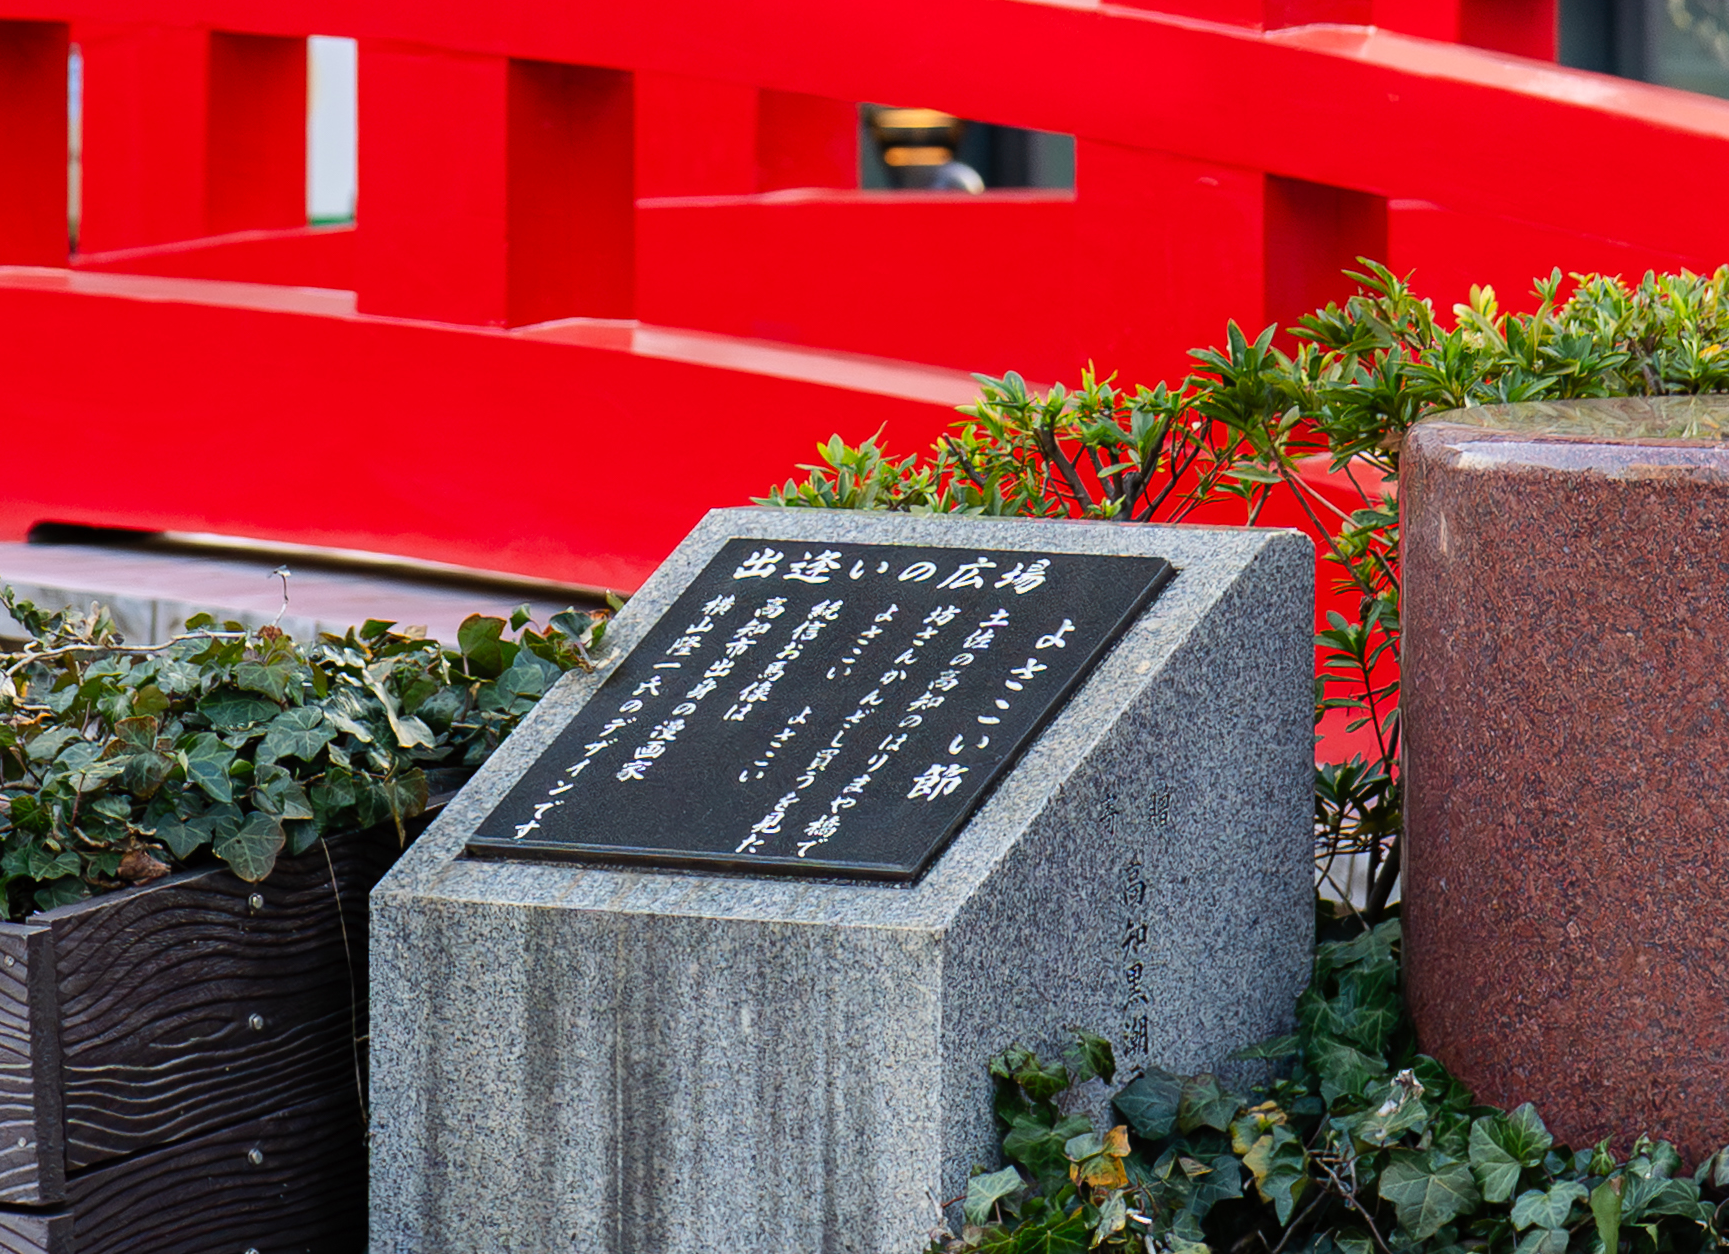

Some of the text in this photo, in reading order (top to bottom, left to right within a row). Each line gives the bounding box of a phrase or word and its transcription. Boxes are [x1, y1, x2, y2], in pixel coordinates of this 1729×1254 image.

[722, 599, 844, 722] 純信お馬像は
[733, 547, 1051, 594] 出逢いの広場
[513, 594, 736, 840] 横山隆一氏のデザインです
[616, 596, 788, 782] 高知市出身の漫画家
[735, 604, 962, 854] 坊さんかんざし買うを見た
[739, 603, 899, 783] よさこい よさこい
[796, 608, 1010, 858] 土佐の高知のはりまや橋で
[906, 618, 1076, 802] よさこい節
[1120, 856, 1149, 1087] 高知黒潮
